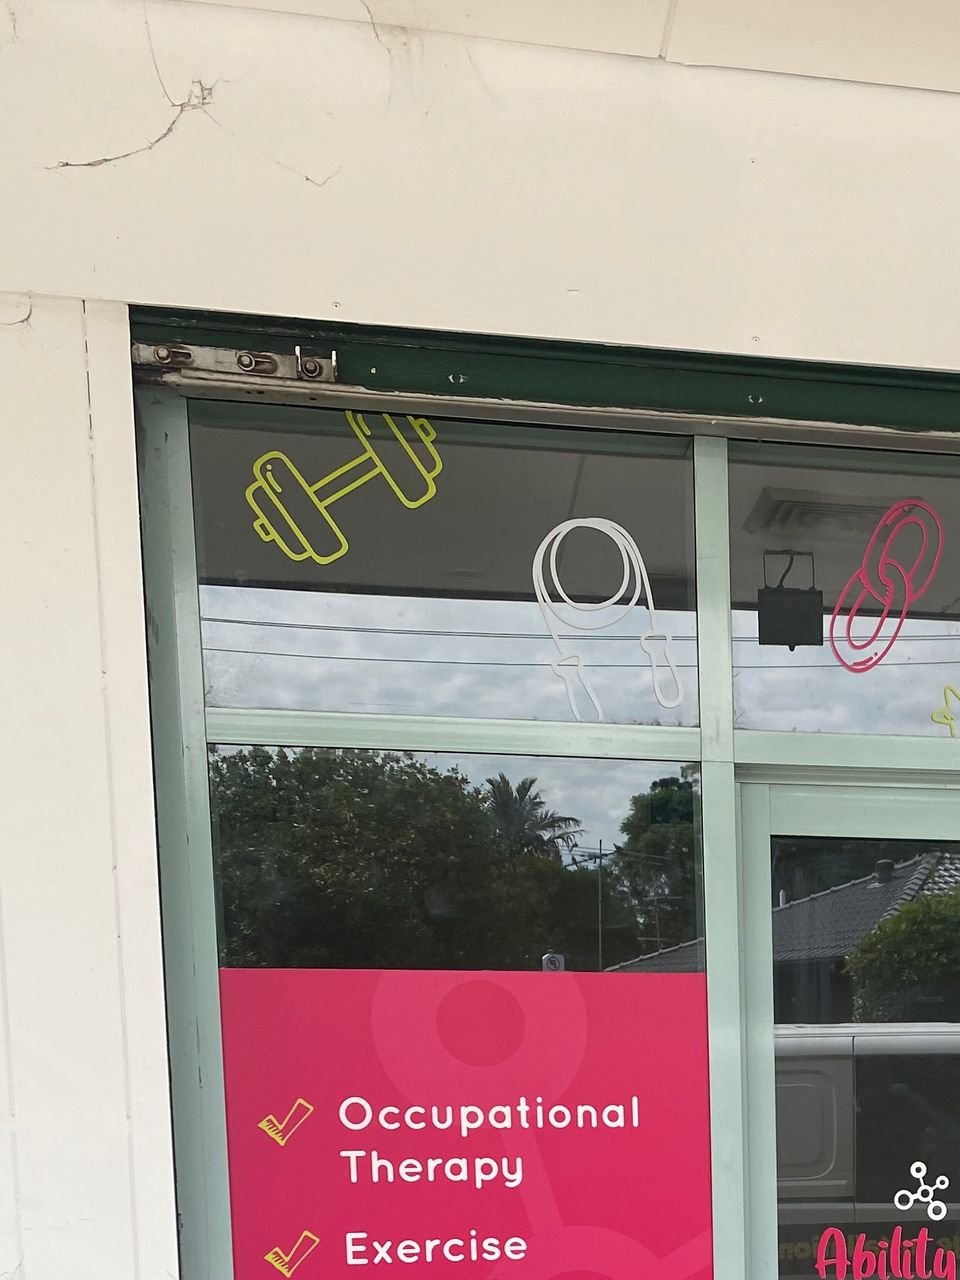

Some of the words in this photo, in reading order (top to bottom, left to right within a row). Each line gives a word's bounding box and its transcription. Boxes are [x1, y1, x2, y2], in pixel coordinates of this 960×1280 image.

[339, 1096, 639, 1137] Occupational
[340, 1150, 523, 1188] Therapy
[346, 1230, 527, 1265] Exercise
